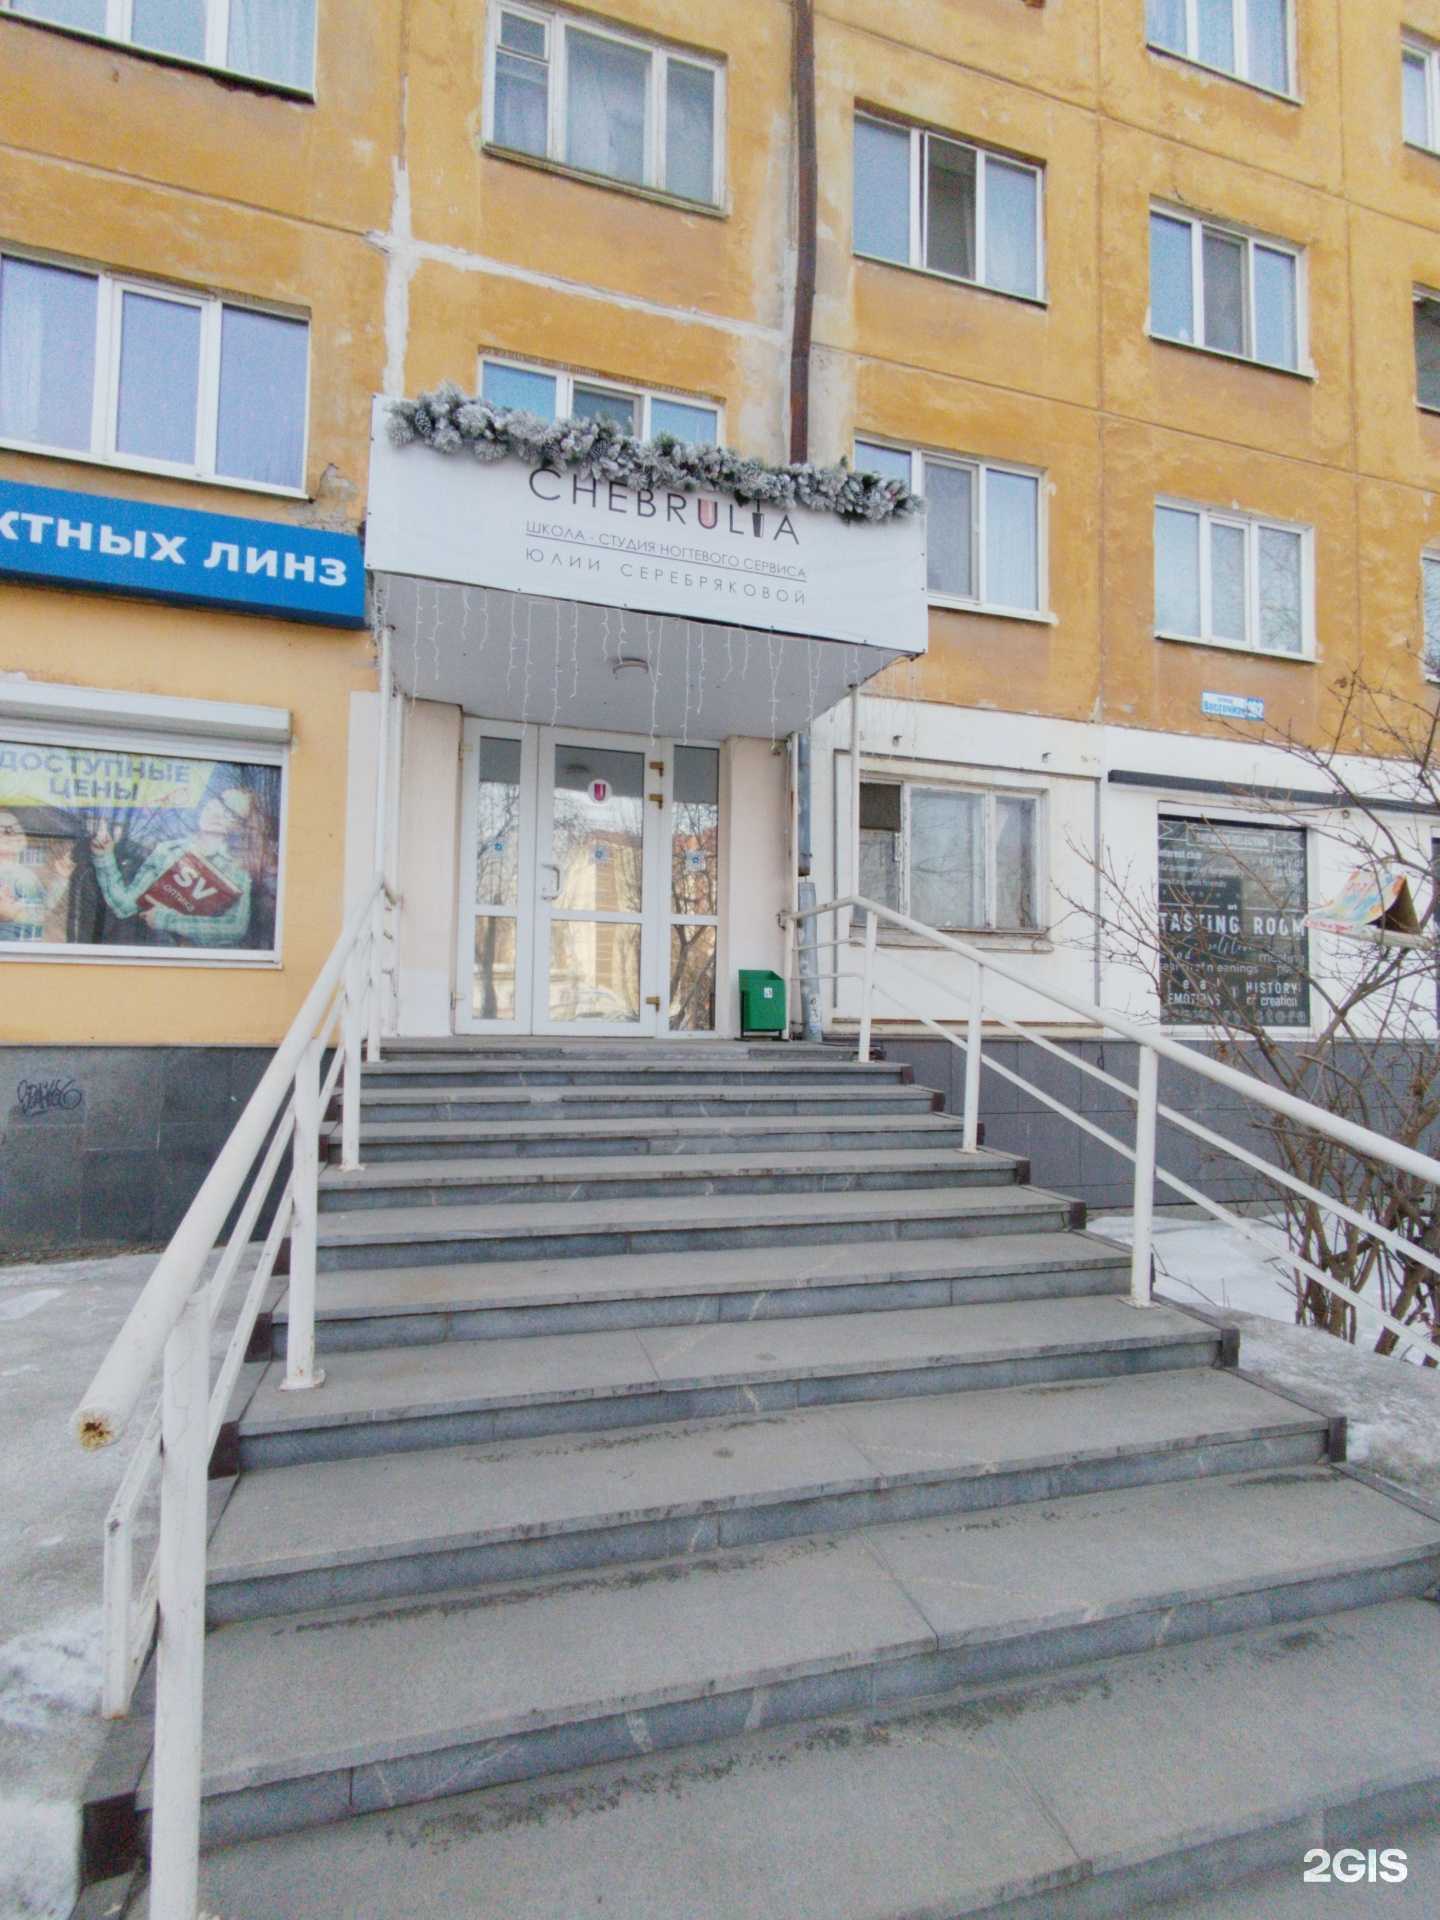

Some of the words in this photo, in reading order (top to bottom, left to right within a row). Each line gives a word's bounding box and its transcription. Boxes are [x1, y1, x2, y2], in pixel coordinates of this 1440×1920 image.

[525, 519, 585, 542] ШКОЛА
[599, 532, 656, 553] СТУДИЯ
[660, 544, 740, 567] НОГТЕВОГО
[743, 557, 807, 578] СЕРВИСА
[525, 547, 601, 572] ЮЛИИ
[620, 562, 806, 606] СЕРЕБРЯКОВОЙ
[0, 748, 191, 784] ДОСТУПНЫЕ
[50, 777, 138, 801] ЦЕНЫ
[173, 866, 218, 900] SV
[1158, 912, 1241, 934] TASTING
[1253, 916, 1306, 937] ROOM
